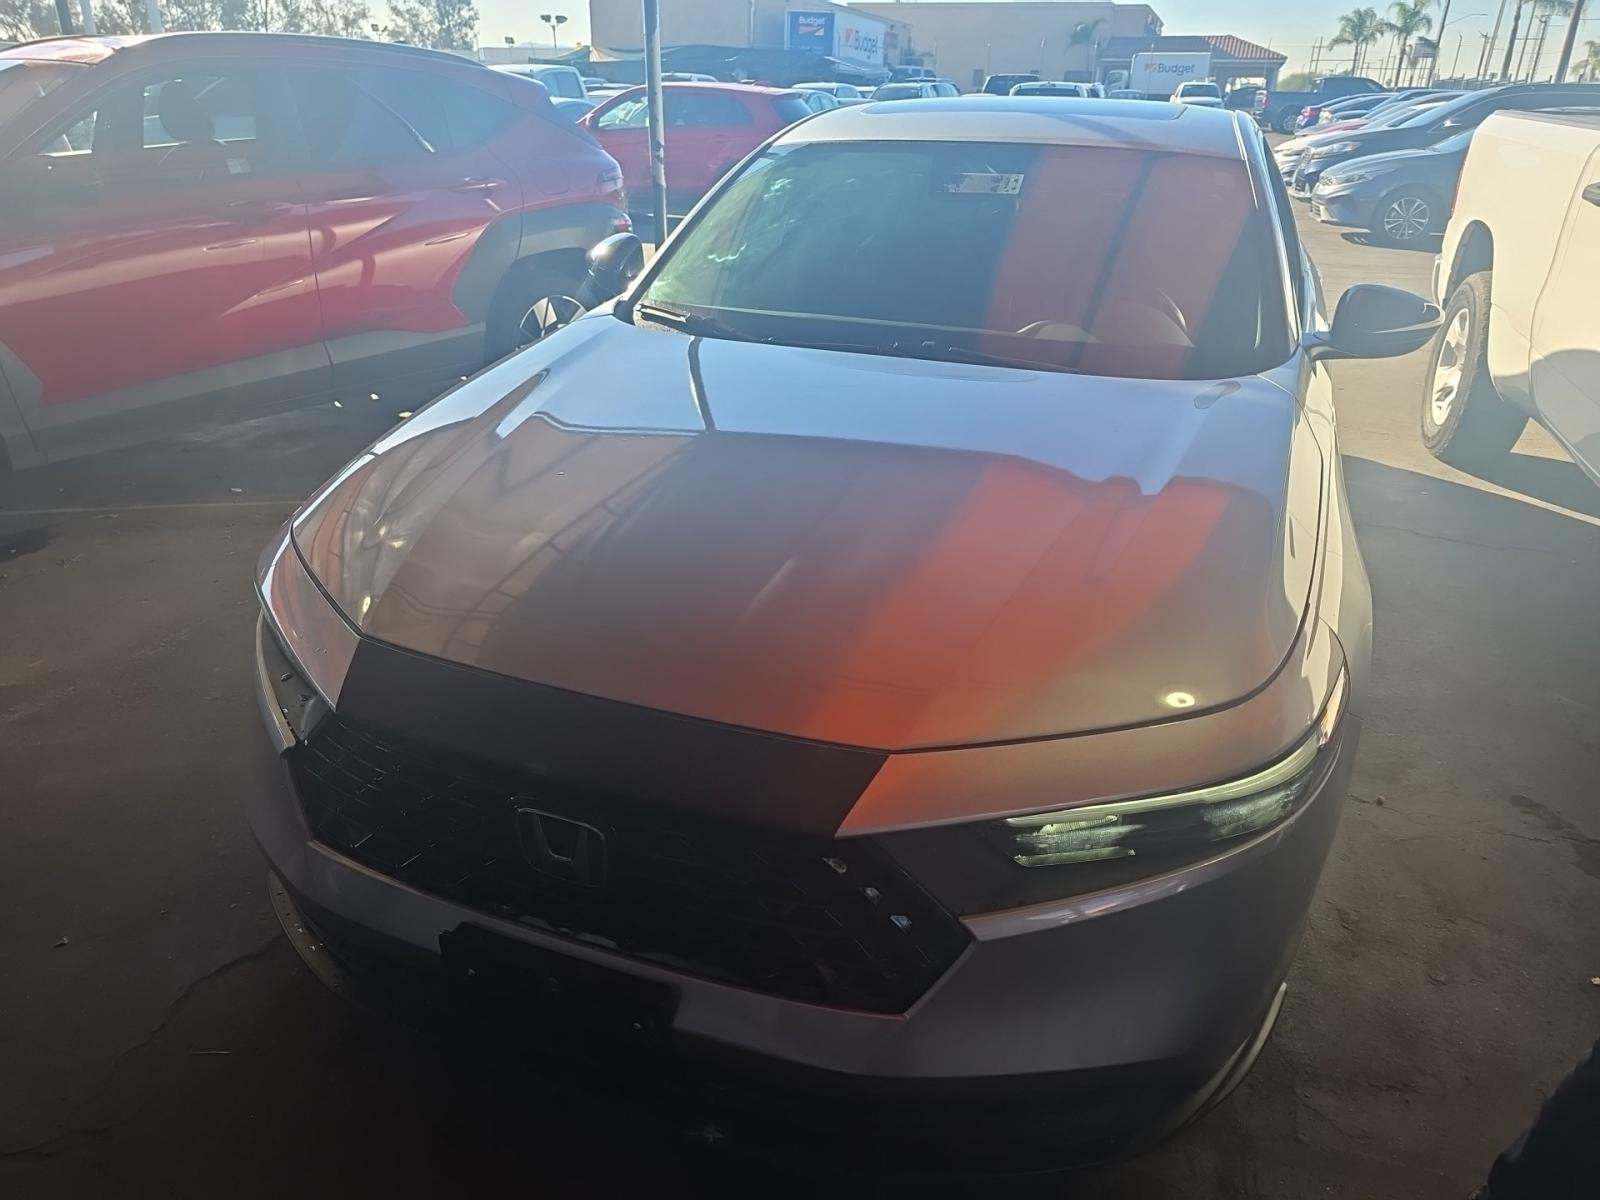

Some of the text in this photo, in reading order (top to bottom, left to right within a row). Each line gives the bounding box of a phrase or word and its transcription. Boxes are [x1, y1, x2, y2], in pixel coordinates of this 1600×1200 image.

[799, 16, 825, 25] Budget
[854, 29, 879, 59] Budget
[1158, 63, 1196, 76] Budget
